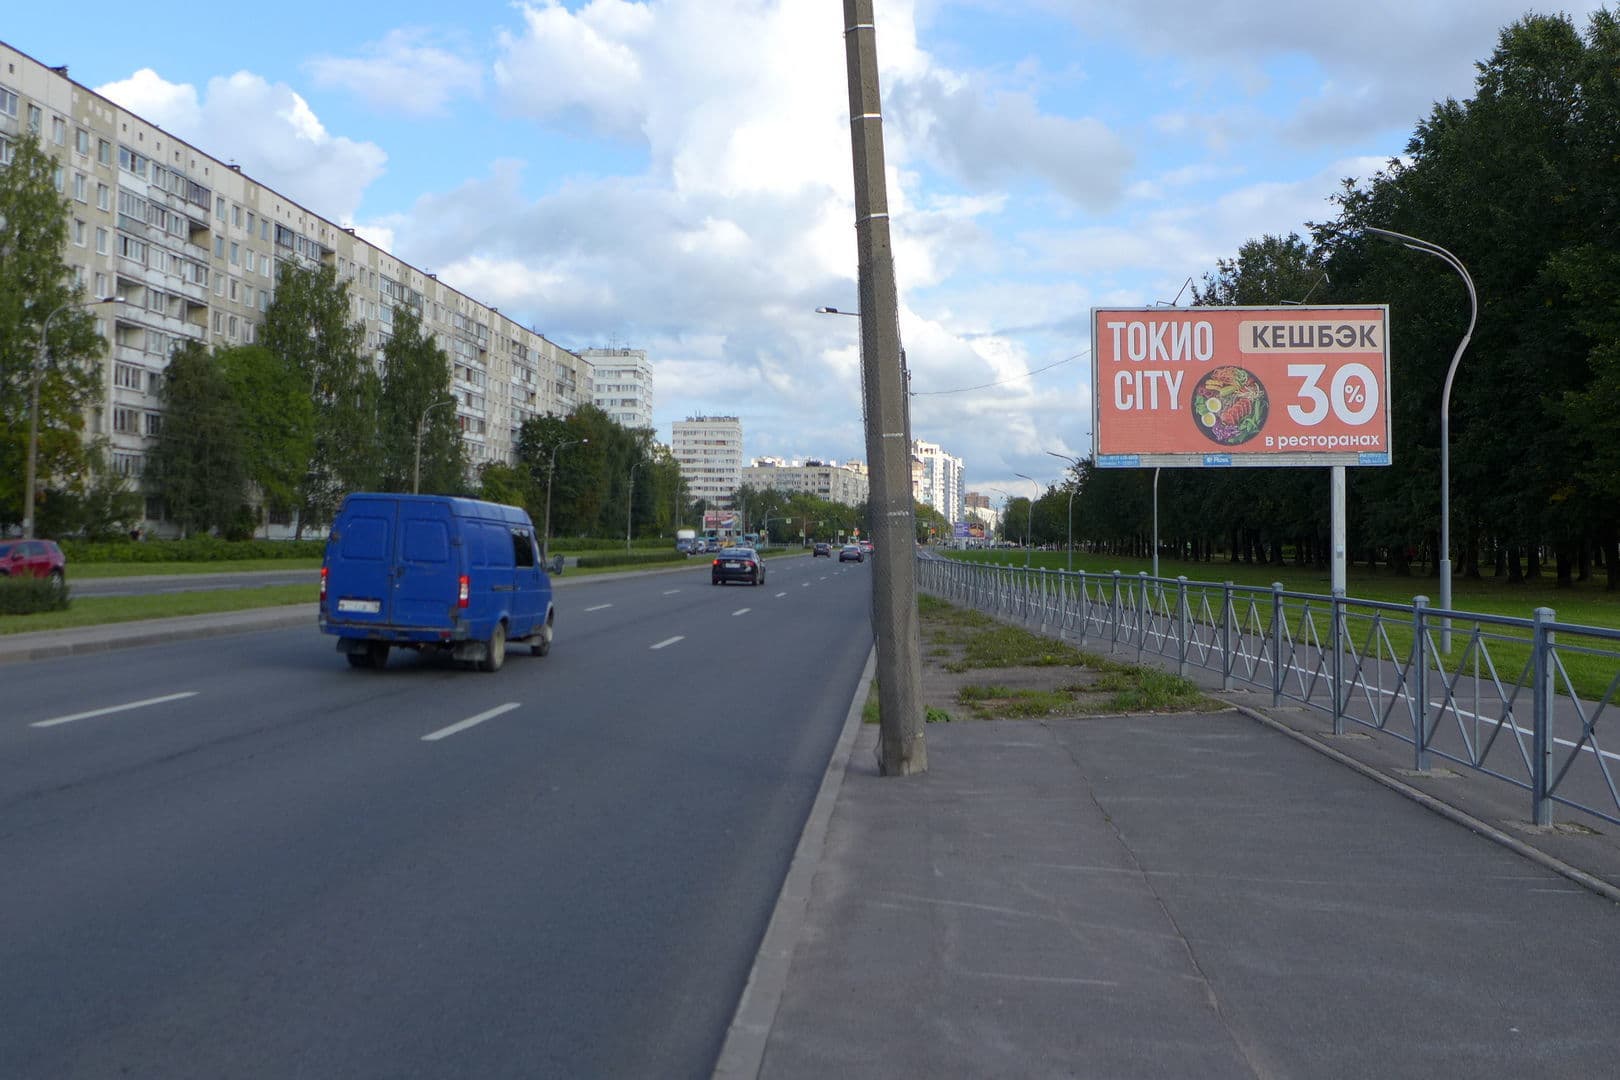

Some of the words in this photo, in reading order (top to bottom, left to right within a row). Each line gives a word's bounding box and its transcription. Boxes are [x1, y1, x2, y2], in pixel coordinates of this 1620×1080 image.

[1107, 321, 1214, 361] ТОКИО
[1252, 324, 1378, 348] КЕШБЭК
[1114, 370, 1184, 410] CITY
[1265, 436, 1274, 446] в
[1278, 434, 1380, 449] ресторанах
